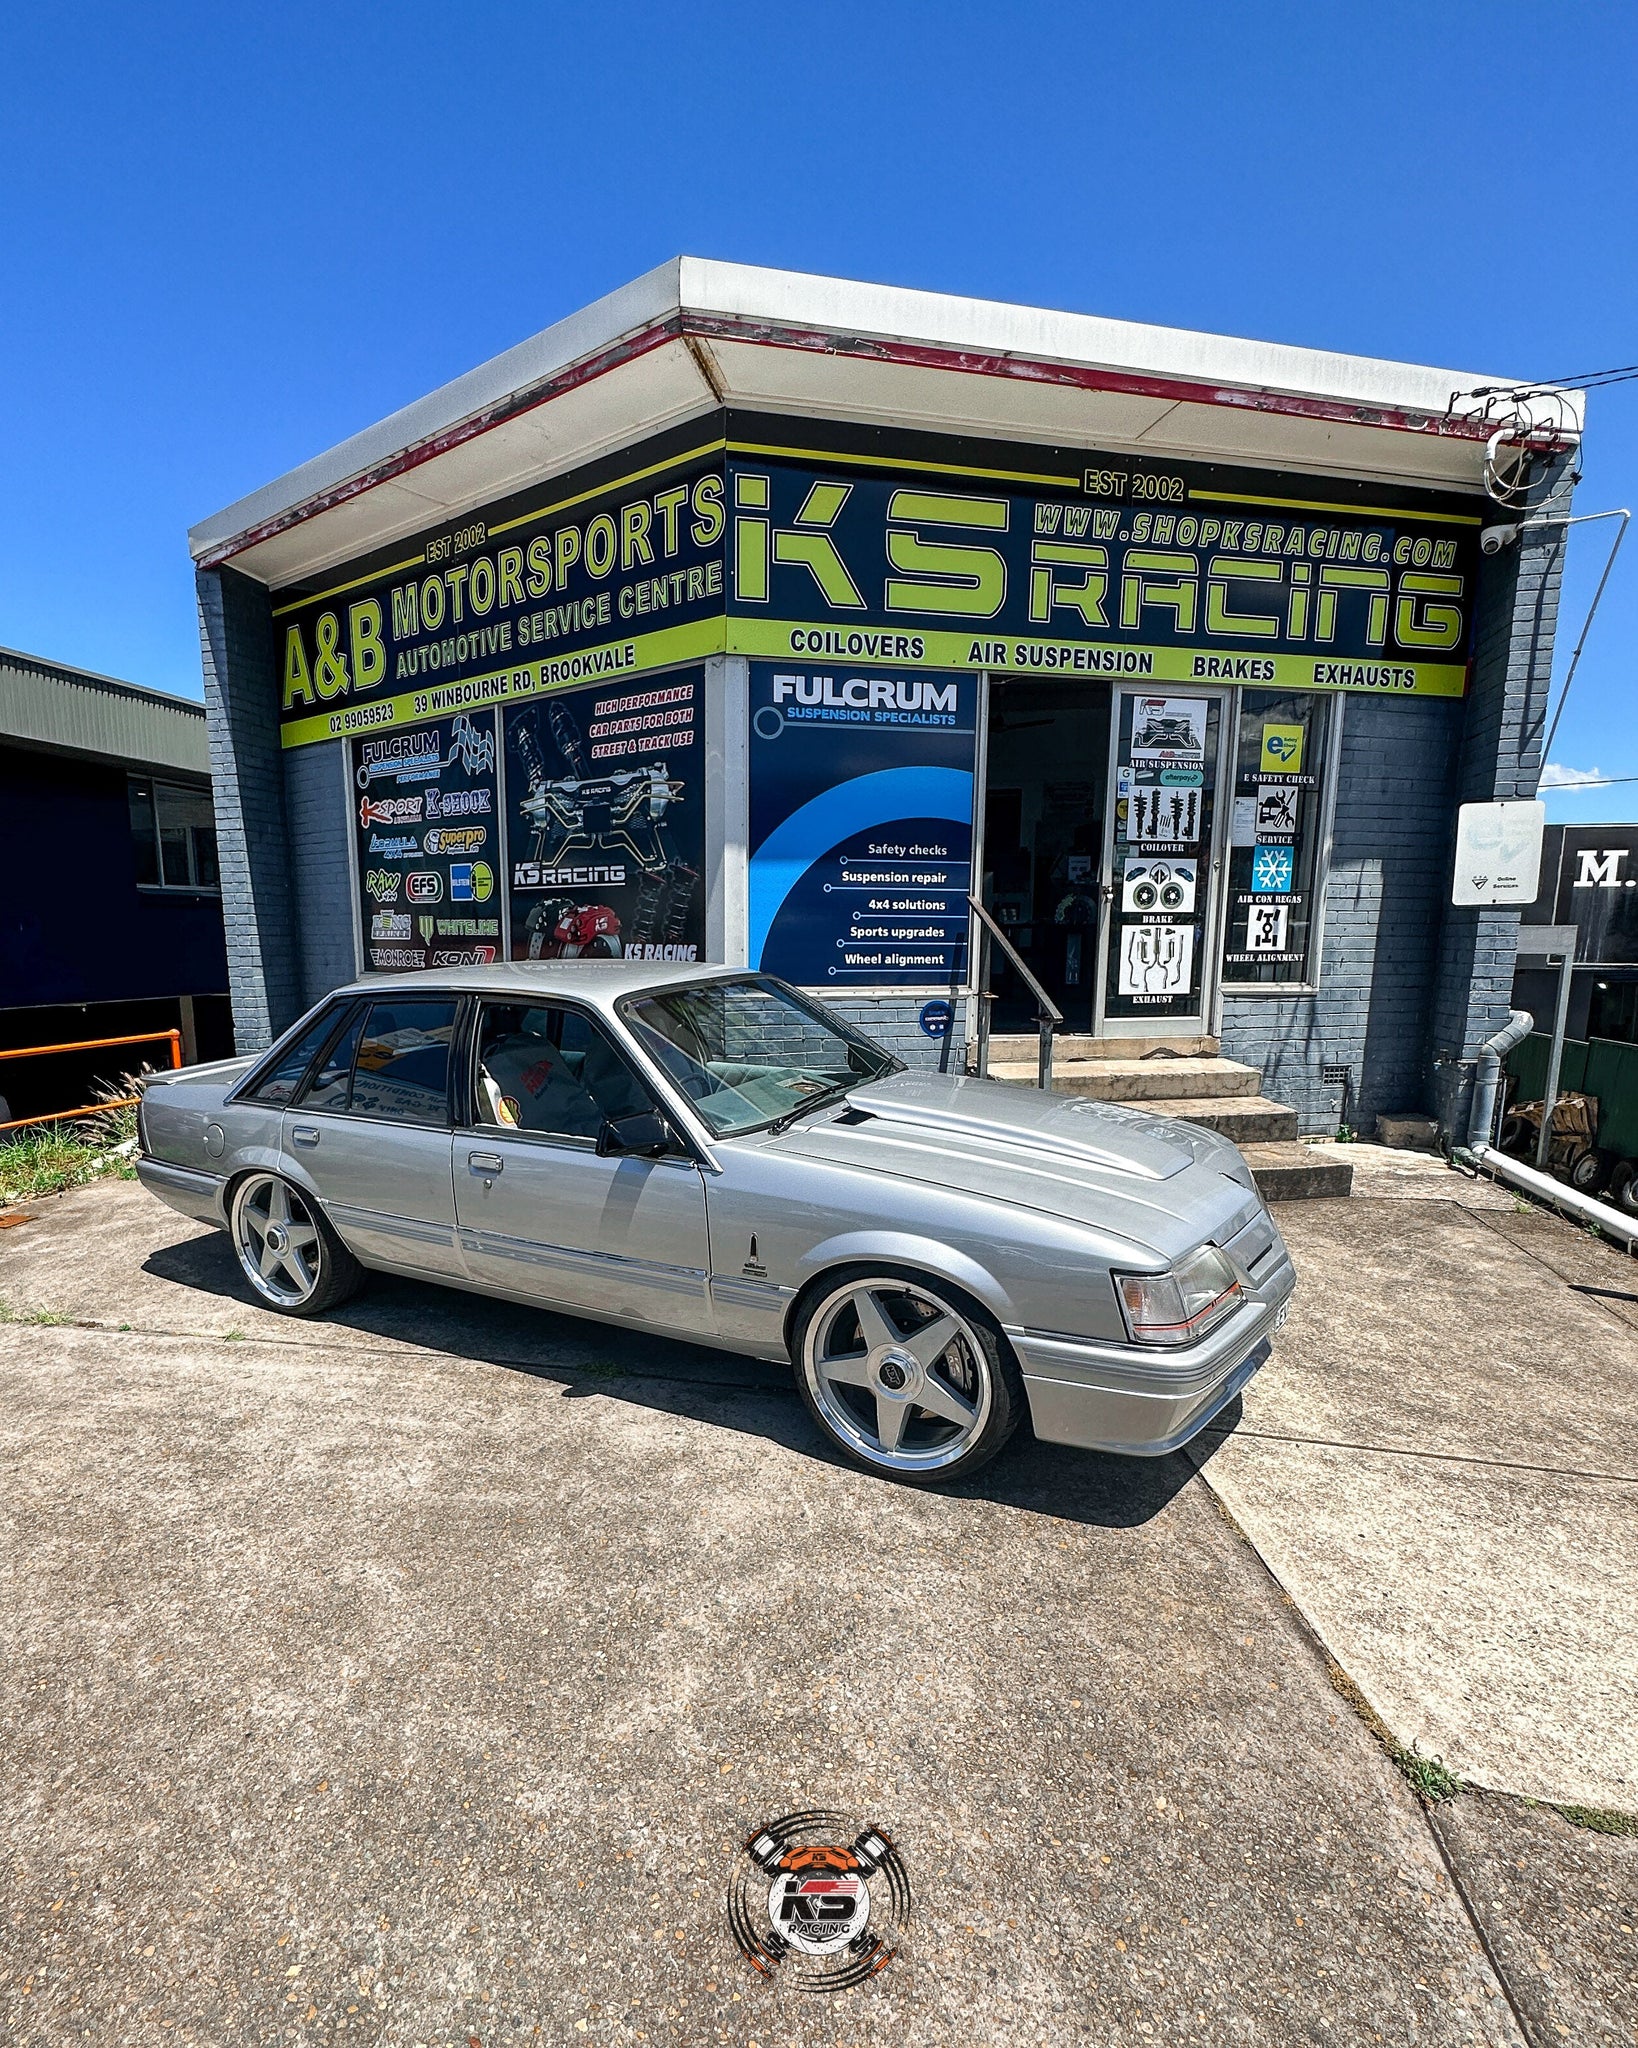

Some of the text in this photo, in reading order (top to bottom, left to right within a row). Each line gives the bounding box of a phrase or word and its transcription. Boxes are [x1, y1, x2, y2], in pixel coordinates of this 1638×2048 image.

[1083, 469, 1185, 502] EST 2002
[426, 522, 486, 563] EST 2002
[1034, 504, 1458, 568] WWW.SHOPKSRACING.COM
[392, 474, 726, 641] MOTORSPORTS
[1029, 541, 1465, 650] RACING
[396, 560, 722, 679] AUTOMOTIVE SERVICE CENTRE
[790, 629, 925, 659] COILOVERS
[283, 599, 386, 710] A&B
[968, 641, 1153, 674] AIR SUSPENSION
[414, 644, 635, 713] 39 WINBOURNE RD, BROOKVALE
[1193, 656, 1275, 681] BRAKES
[1313, 663, 1416, 689] EXHAUSTS
[594, 684, 694, 716] HIGH PERFORMANCE
[772, 674, 957, 712] FULCRUM
[329, 703, 394, 733] 02 99059523
[589, 707, 694, 738] CAR PARTS FOR BOTH
[787, 707, 956, 725] SUSPENSION SPECIALISTS
[362, 730, 440, 764] FULCRUM
[591, 730, 694, 758] STREET & TRACK USE
[1129, 759, 1204, 771] AIR SUSPENSION
[1165, 773, 1191, 782] afterpay
[1243, 774, 1315, 784] E SAFETY CHECK
[424, 787, 492, 819] K-SHOCK
[868, 843, 947, 856] Safety checks
[1140, 843, 1185, 852] COILOVER
[1257, 835, 1293, 844] SERVICE
[366, 868, 401, 902] RAW
[542, 865, 626, 885] RACING
[842, 871, 947, 885] Suspension repair
[411, 877, 436, 894] EFS
[868, 899, 946, 911] 4x4 solutions
[1237, 895, 1302, 904] AIR CON REGAS
[436, 919, 498, 936] WHITELINE
[1142, 915, 1173, 924] BRAKE
[850, 926, 945, 939] Sports upgrades
[377, 949, 423, 968] MONROE
[432, 951, 486, 966] KONI
[624, 943, 698, 962] KS RACING
[845, 953, 945, 966] Wheel alignment
[1226, 954, 1305, 962] WHEEL ALIGNMENT
[1132, 995, 1173, 1004] EXHAUST
